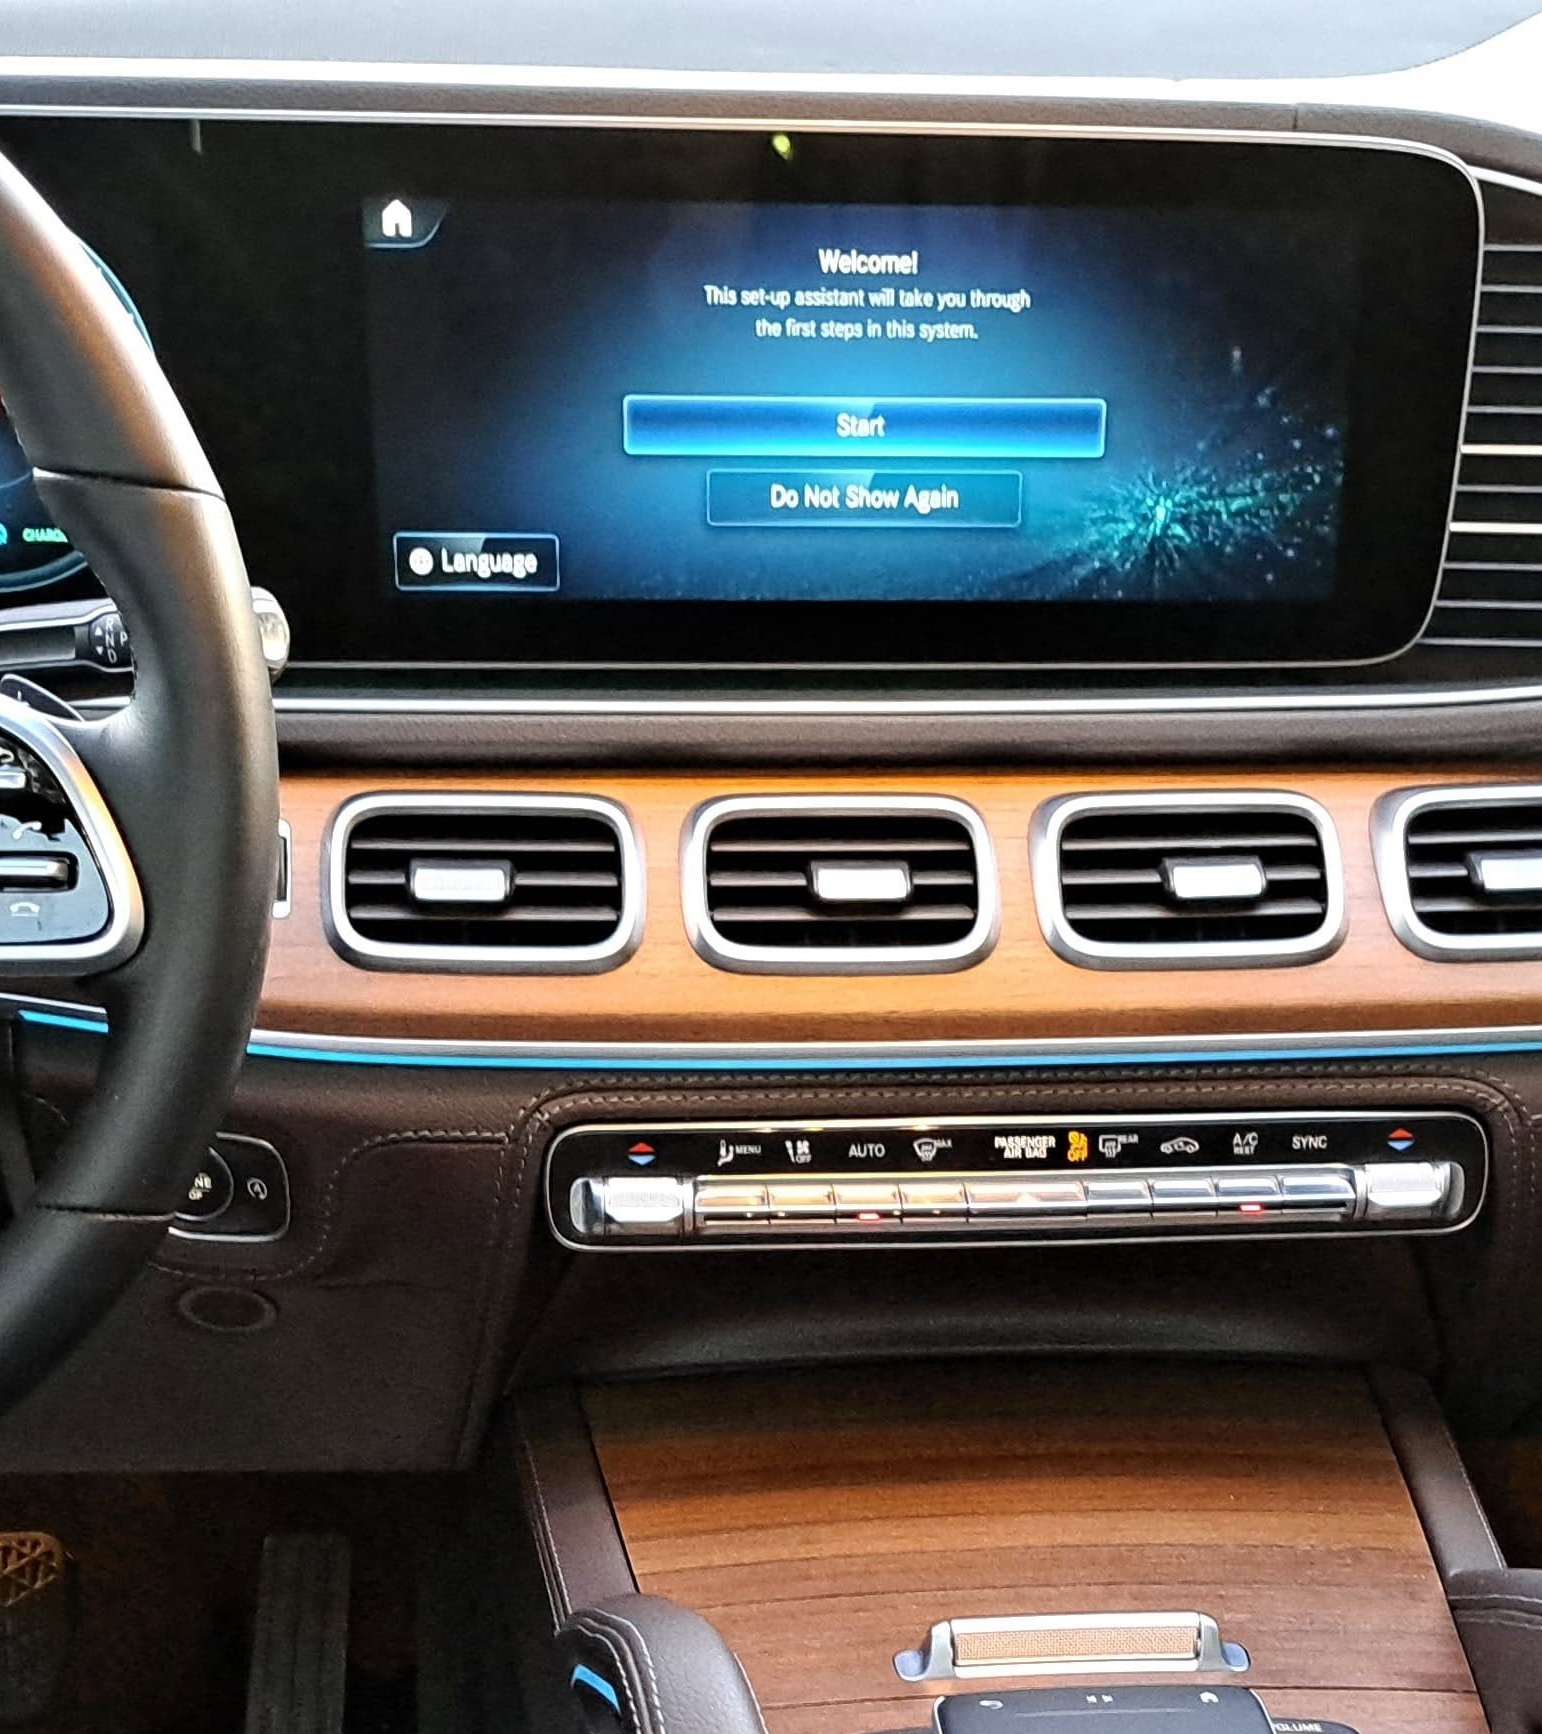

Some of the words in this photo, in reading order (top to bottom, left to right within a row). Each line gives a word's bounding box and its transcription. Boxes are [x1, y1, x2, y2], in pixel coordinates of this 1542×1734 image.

[818, 248, 918, 274] Welcome!
[703, 284, 736, 305] This
[740, 286, 790, 310] set-up
[794, 287, 864, 307] assistant
[867, 287, 895, 306] will
[899, 288, 933, 307] take
[936, 292, 966, 311] you
[970, 288, 1030, 312] through
[755, 317, 782, 337] the
[785, 317, 816, 337] first
[820, 320, 862, 341] steps
[867, 318, 881, 338] in
[886, 319, 914, 338] this
[919, 321, 978, 342] system.
[835, 412, 885, 437] Start
[770, 482, 799, 508] Do
[803, 482, 841, 508] Not
[845, 482, 899, 509] Show
[903, 482, 959, 514] Again
[441, 546, 538, 579] Language
[735, 1144, 762, 1155] MENU
[848, 1142, 885, 1158] AUTO
[993, 1135, 1056, 1148] PASSENGER
[1232, 1131, 1258, 1147] A/C
[1291, 1134, 1327, 1149] SYNC
